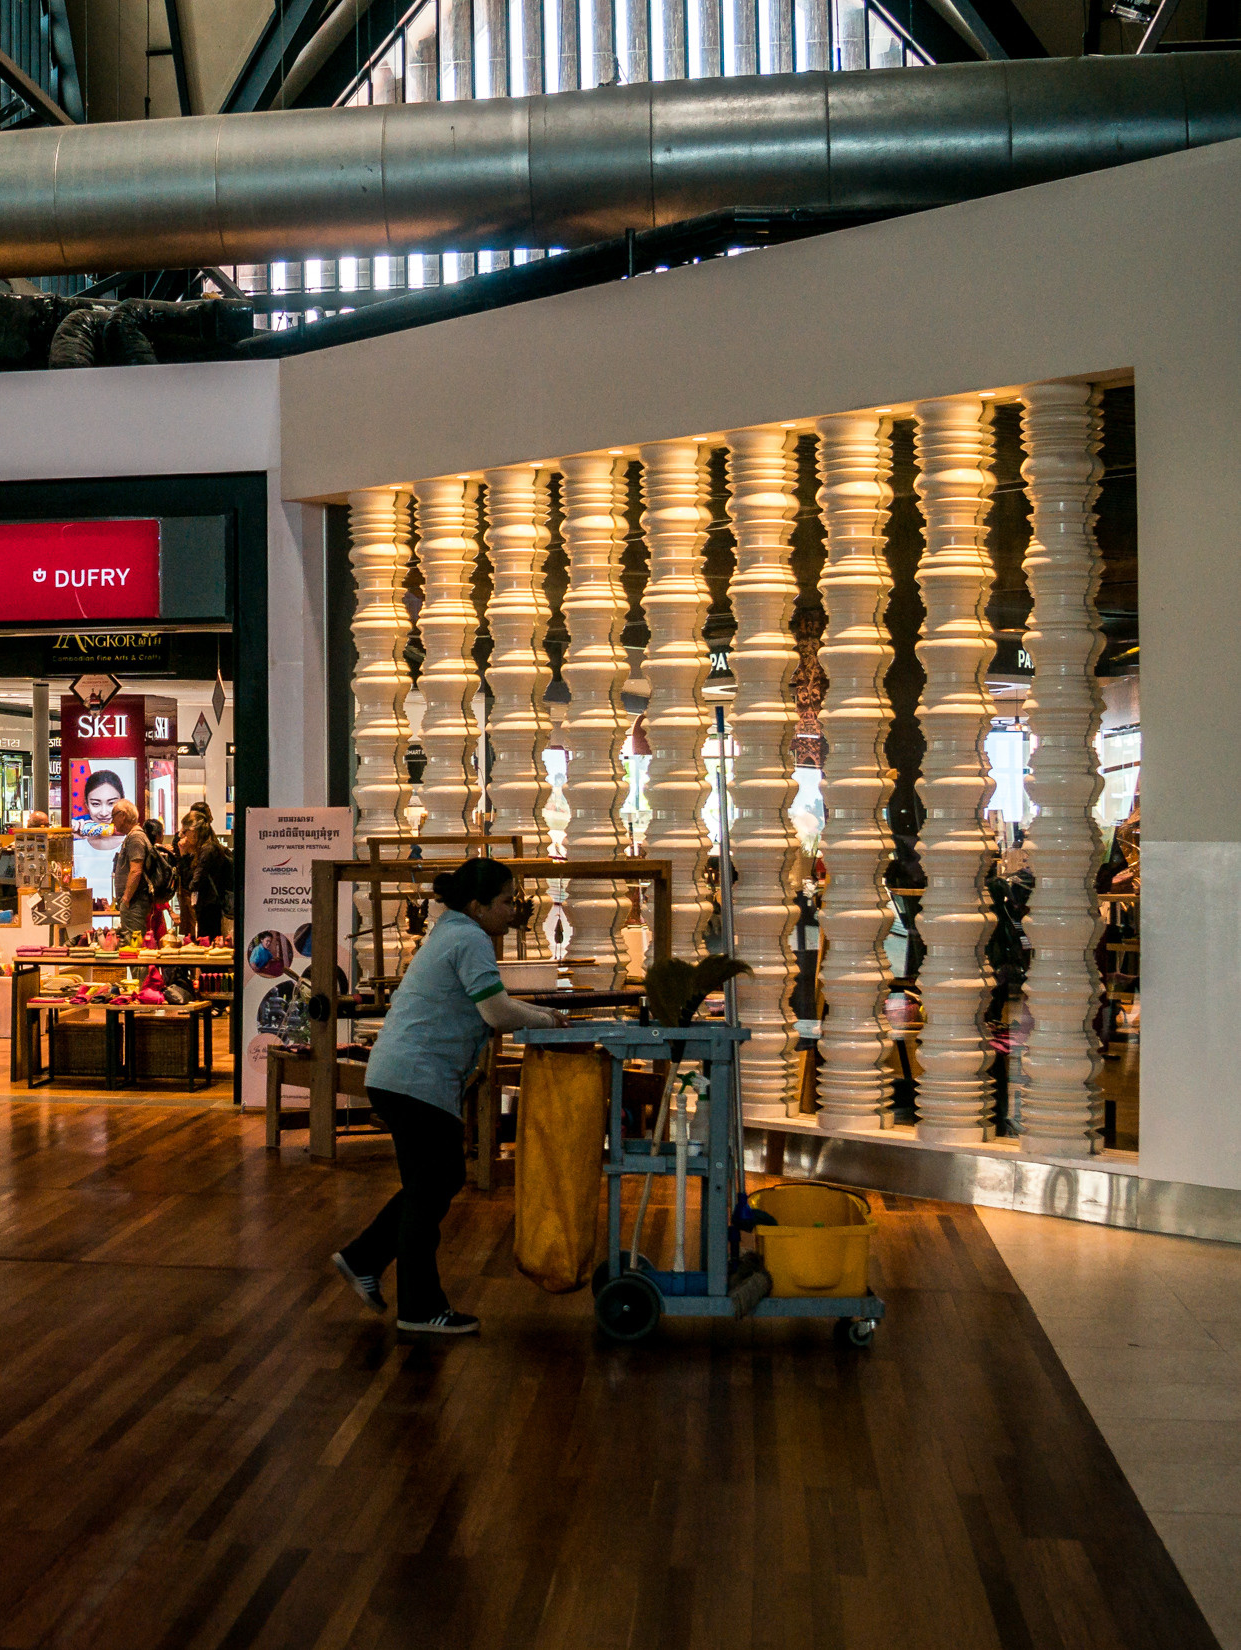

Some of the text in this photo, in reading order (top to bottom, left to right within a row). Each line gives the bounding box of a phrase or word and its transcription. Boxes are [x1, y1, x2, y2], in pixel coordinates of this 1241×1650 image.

[55, 568, 130, 588] DUFRY
[77, 715, 129, 738] SK-II
[270, 886, 312, 896] DISCOV
